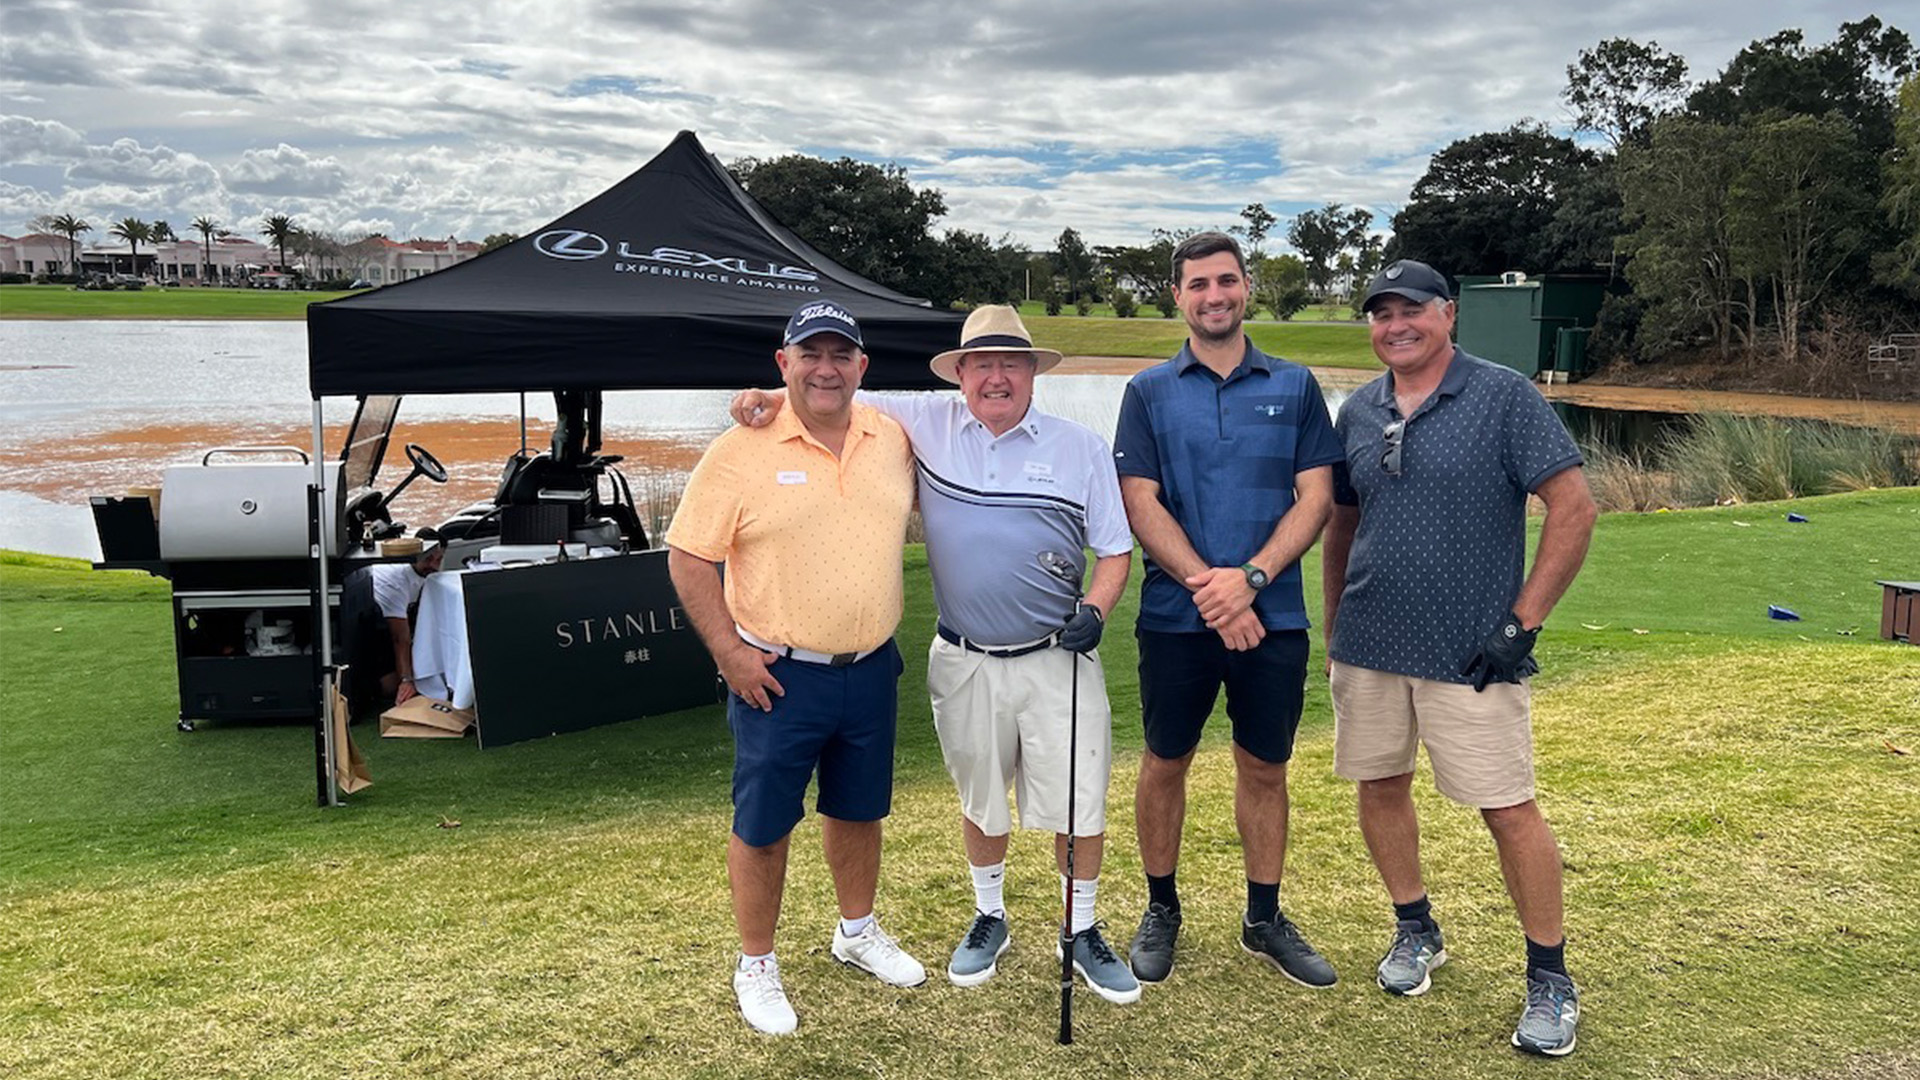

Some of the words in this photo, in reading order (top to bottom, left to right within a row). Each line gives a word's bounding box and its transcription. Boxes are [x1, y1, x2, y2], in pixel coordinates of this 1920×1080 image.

[614, 262, 729, 283] EXPERIENCE
[736, 278, 820, 293] AMAZING
[617, 241, 819, 281] LEXUS
[556, 606, 685, 648] STANLE
[624, 648, 650, 663] 赤柱
